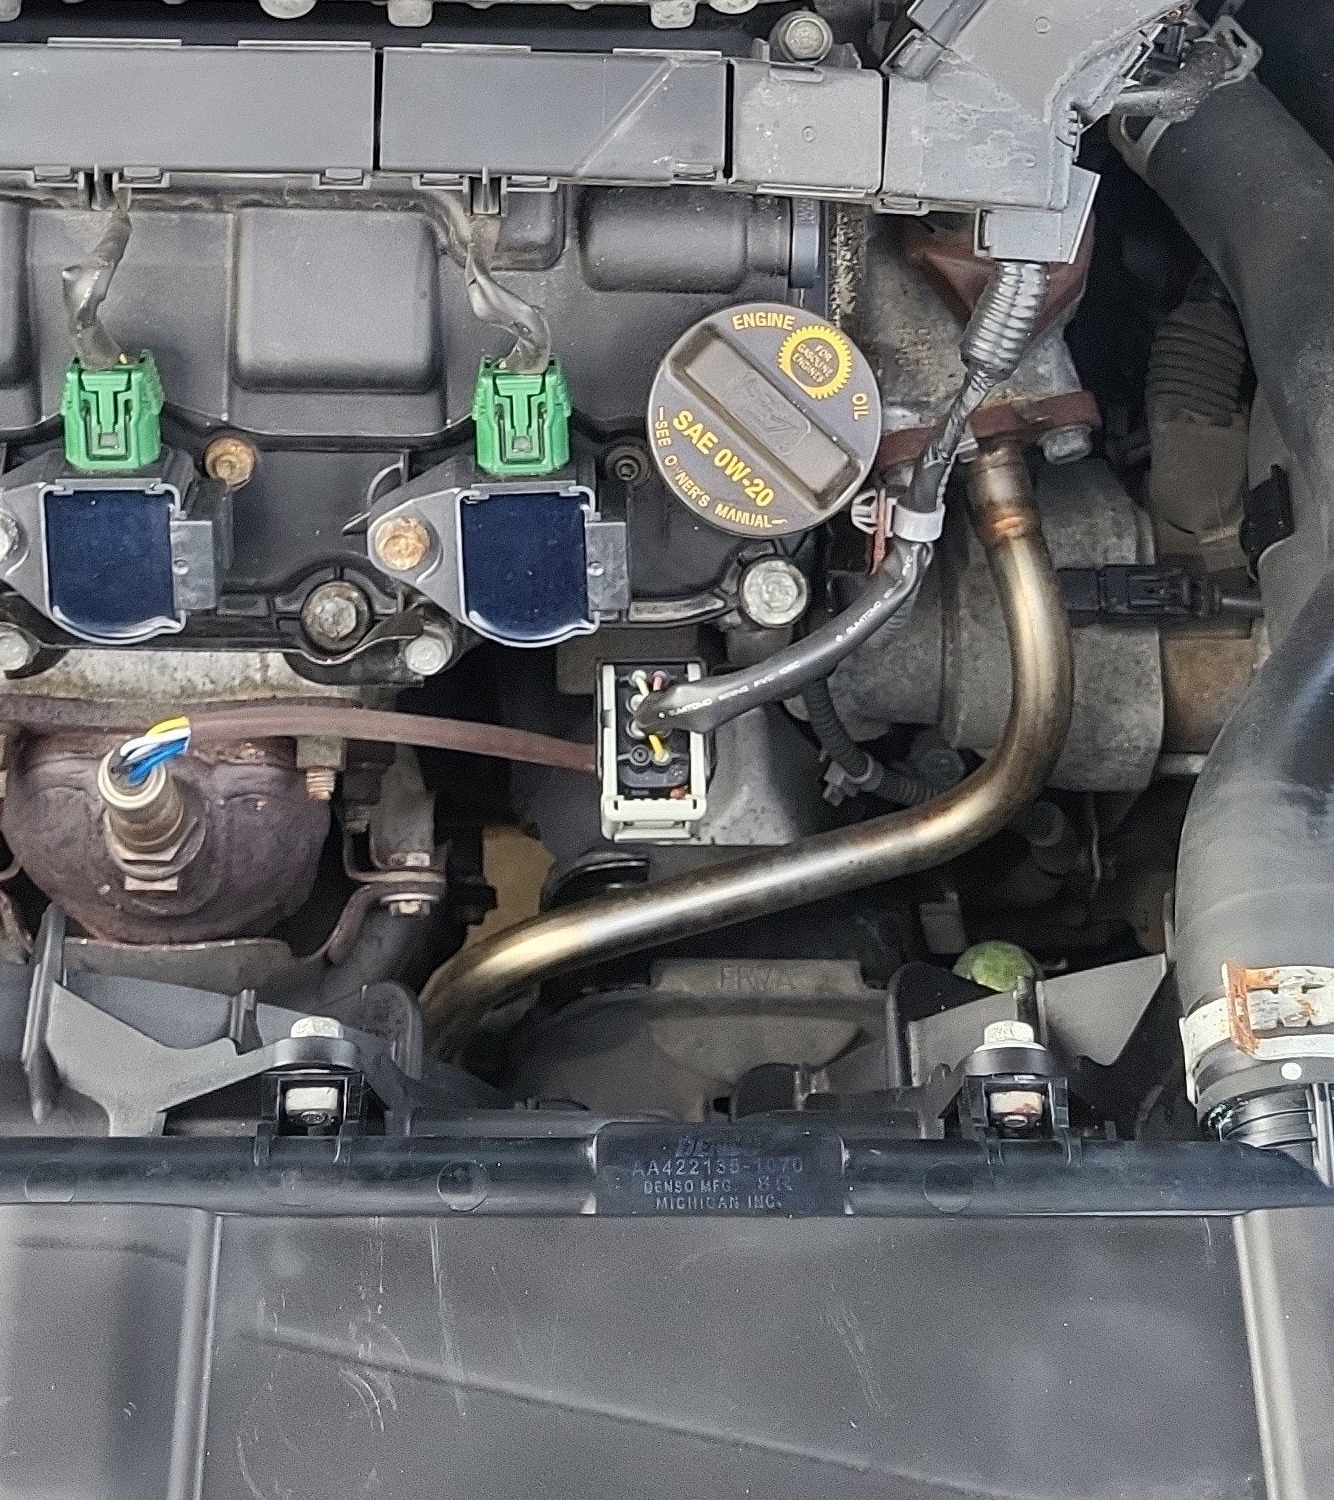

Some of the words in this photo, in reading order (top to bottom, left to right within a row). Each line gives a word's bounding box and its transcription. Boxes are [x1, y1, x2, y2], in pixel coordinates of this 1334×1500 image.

[732, 312, 796, 331] ENGINE
[851, 393, 869, 421] OIL
[673, 410, 719, 455] SAE
[713, 448, 775, 507] 0W-20
[664, 454, 711, 508] ONER'S
[644, 1179, 694, 1194] DENSO
